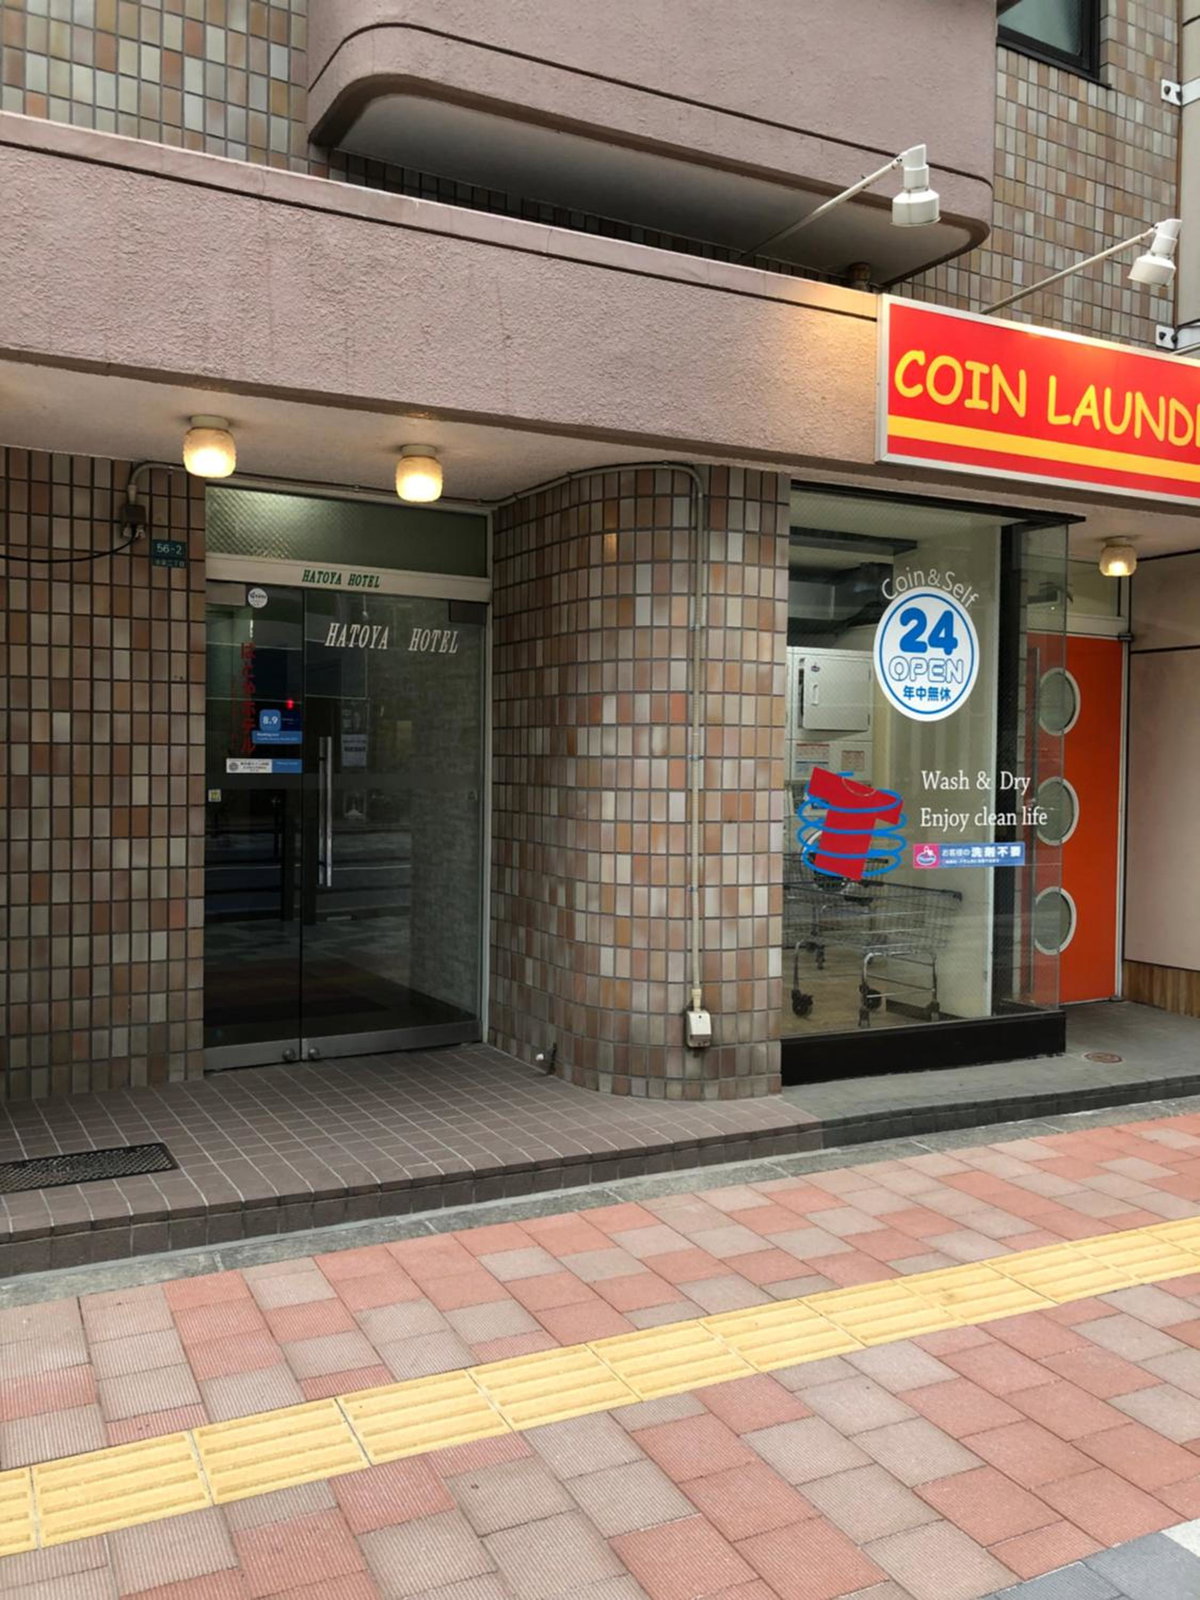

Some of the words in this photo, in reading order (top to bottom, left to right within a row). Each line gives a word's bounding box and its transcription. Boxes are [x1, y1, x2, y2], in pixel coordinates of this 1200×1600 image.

[894, 350, 1027, 418] COIN
[1047, 375, 1200, 447] LAUND
[302, 569, 342, 585] HATOYA
[348, 574, 380, 588] HOTEL
[324, 622, 390, 650] HATOYA
[408, 628, 458, 654] HOTEL
[899, 607, 958, 656] 24
[888, 655, 964, 684] OPEN
[903, 685, 951, 701] 年中無休
[262, 716, 279, 726] 8.9
[921, 770, 970, 790] Wash
[976, 771, 991, 790] &
[1000, 771, 1031, 796] Dry
[920, 807, 970, 832] Enjoy
[974, 806, 1017, 826] clean
[1021, 806, 1048, 825] life
